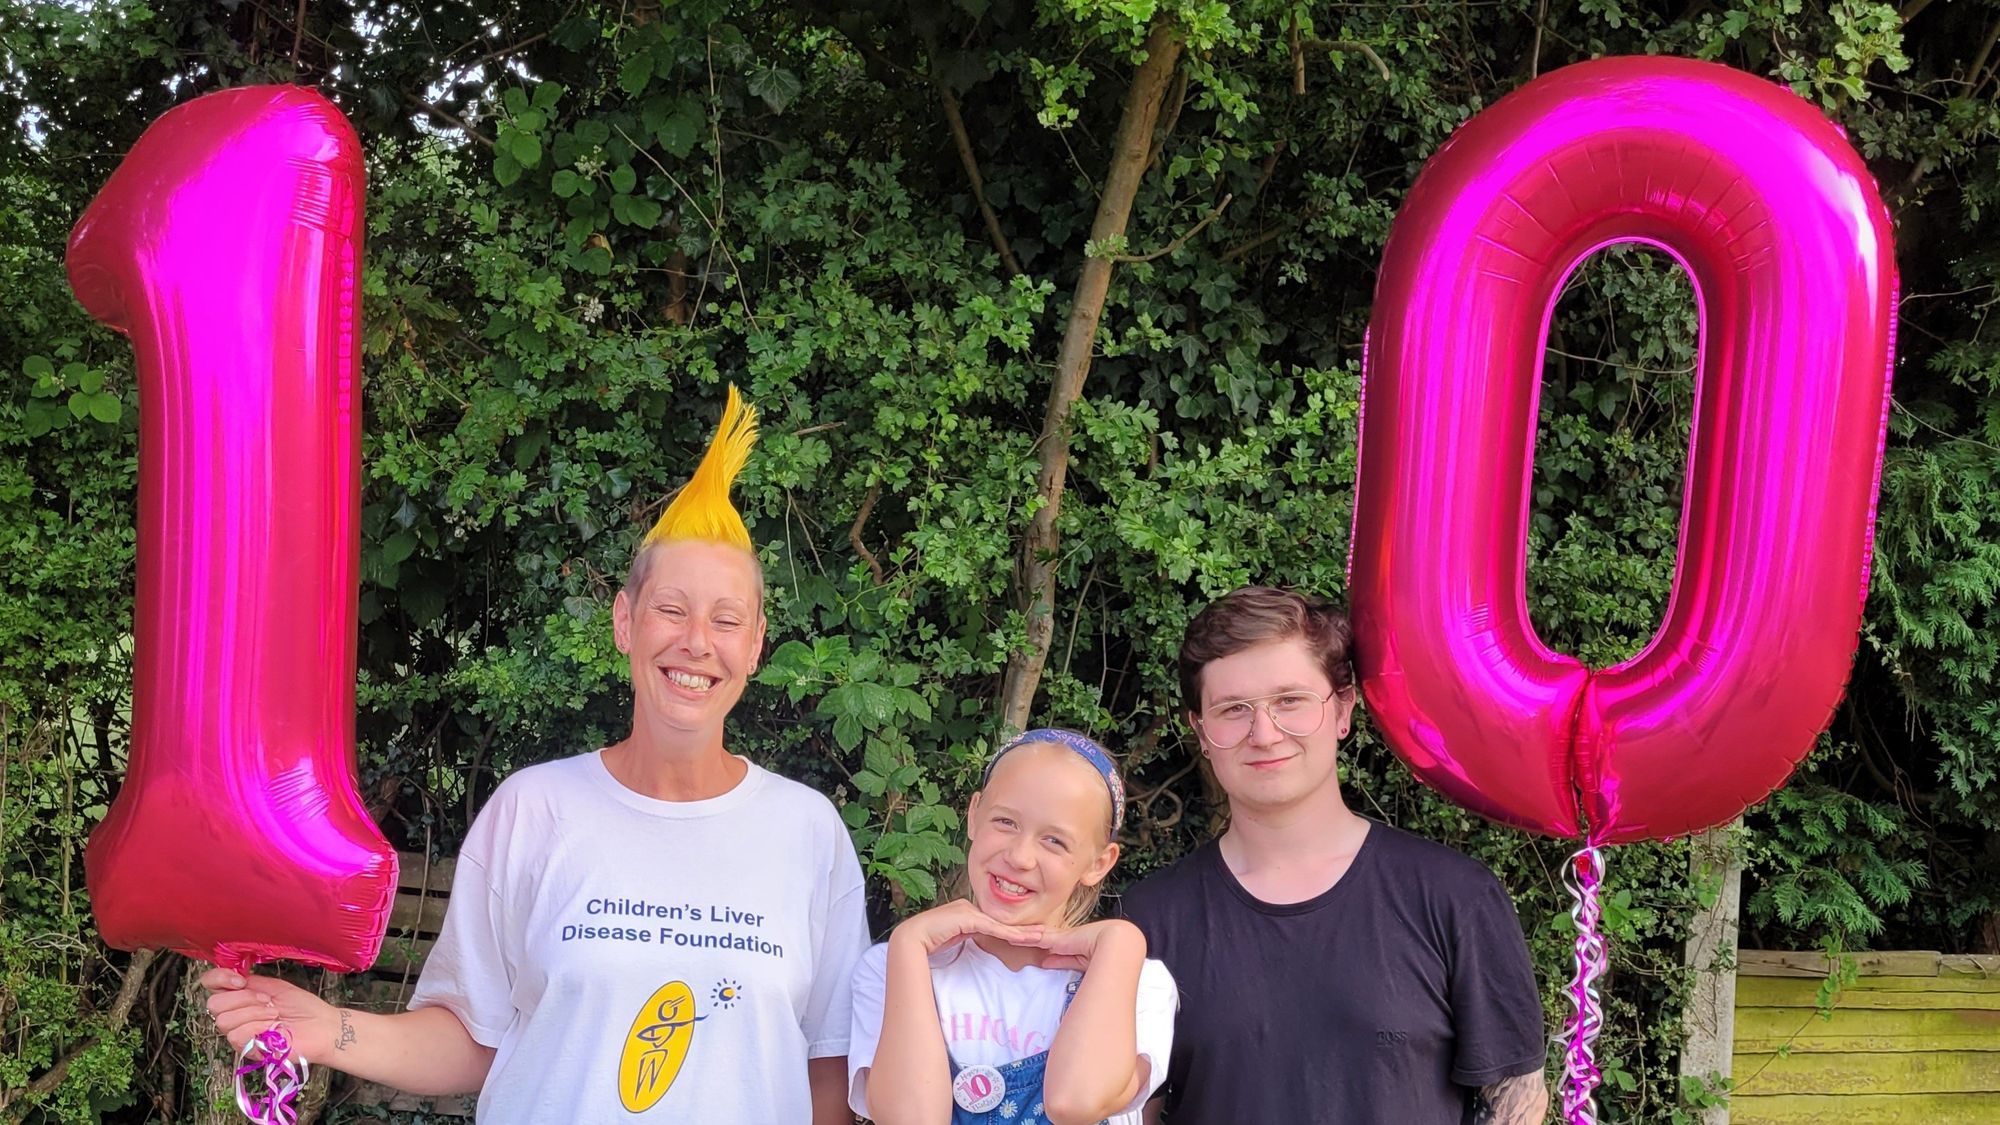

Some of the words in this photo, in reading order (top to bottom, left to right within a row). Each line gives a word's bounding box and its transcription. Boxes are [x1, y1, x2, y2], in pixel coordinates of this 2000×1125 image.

[1046, 729, 1097, 756] Sophie
[710, 905, 764, 927] Liver
[562, 924, 652, 942] Disease
[660, 927, 783, 958] Foundation
[957, 1073, 992, 1106] 10
